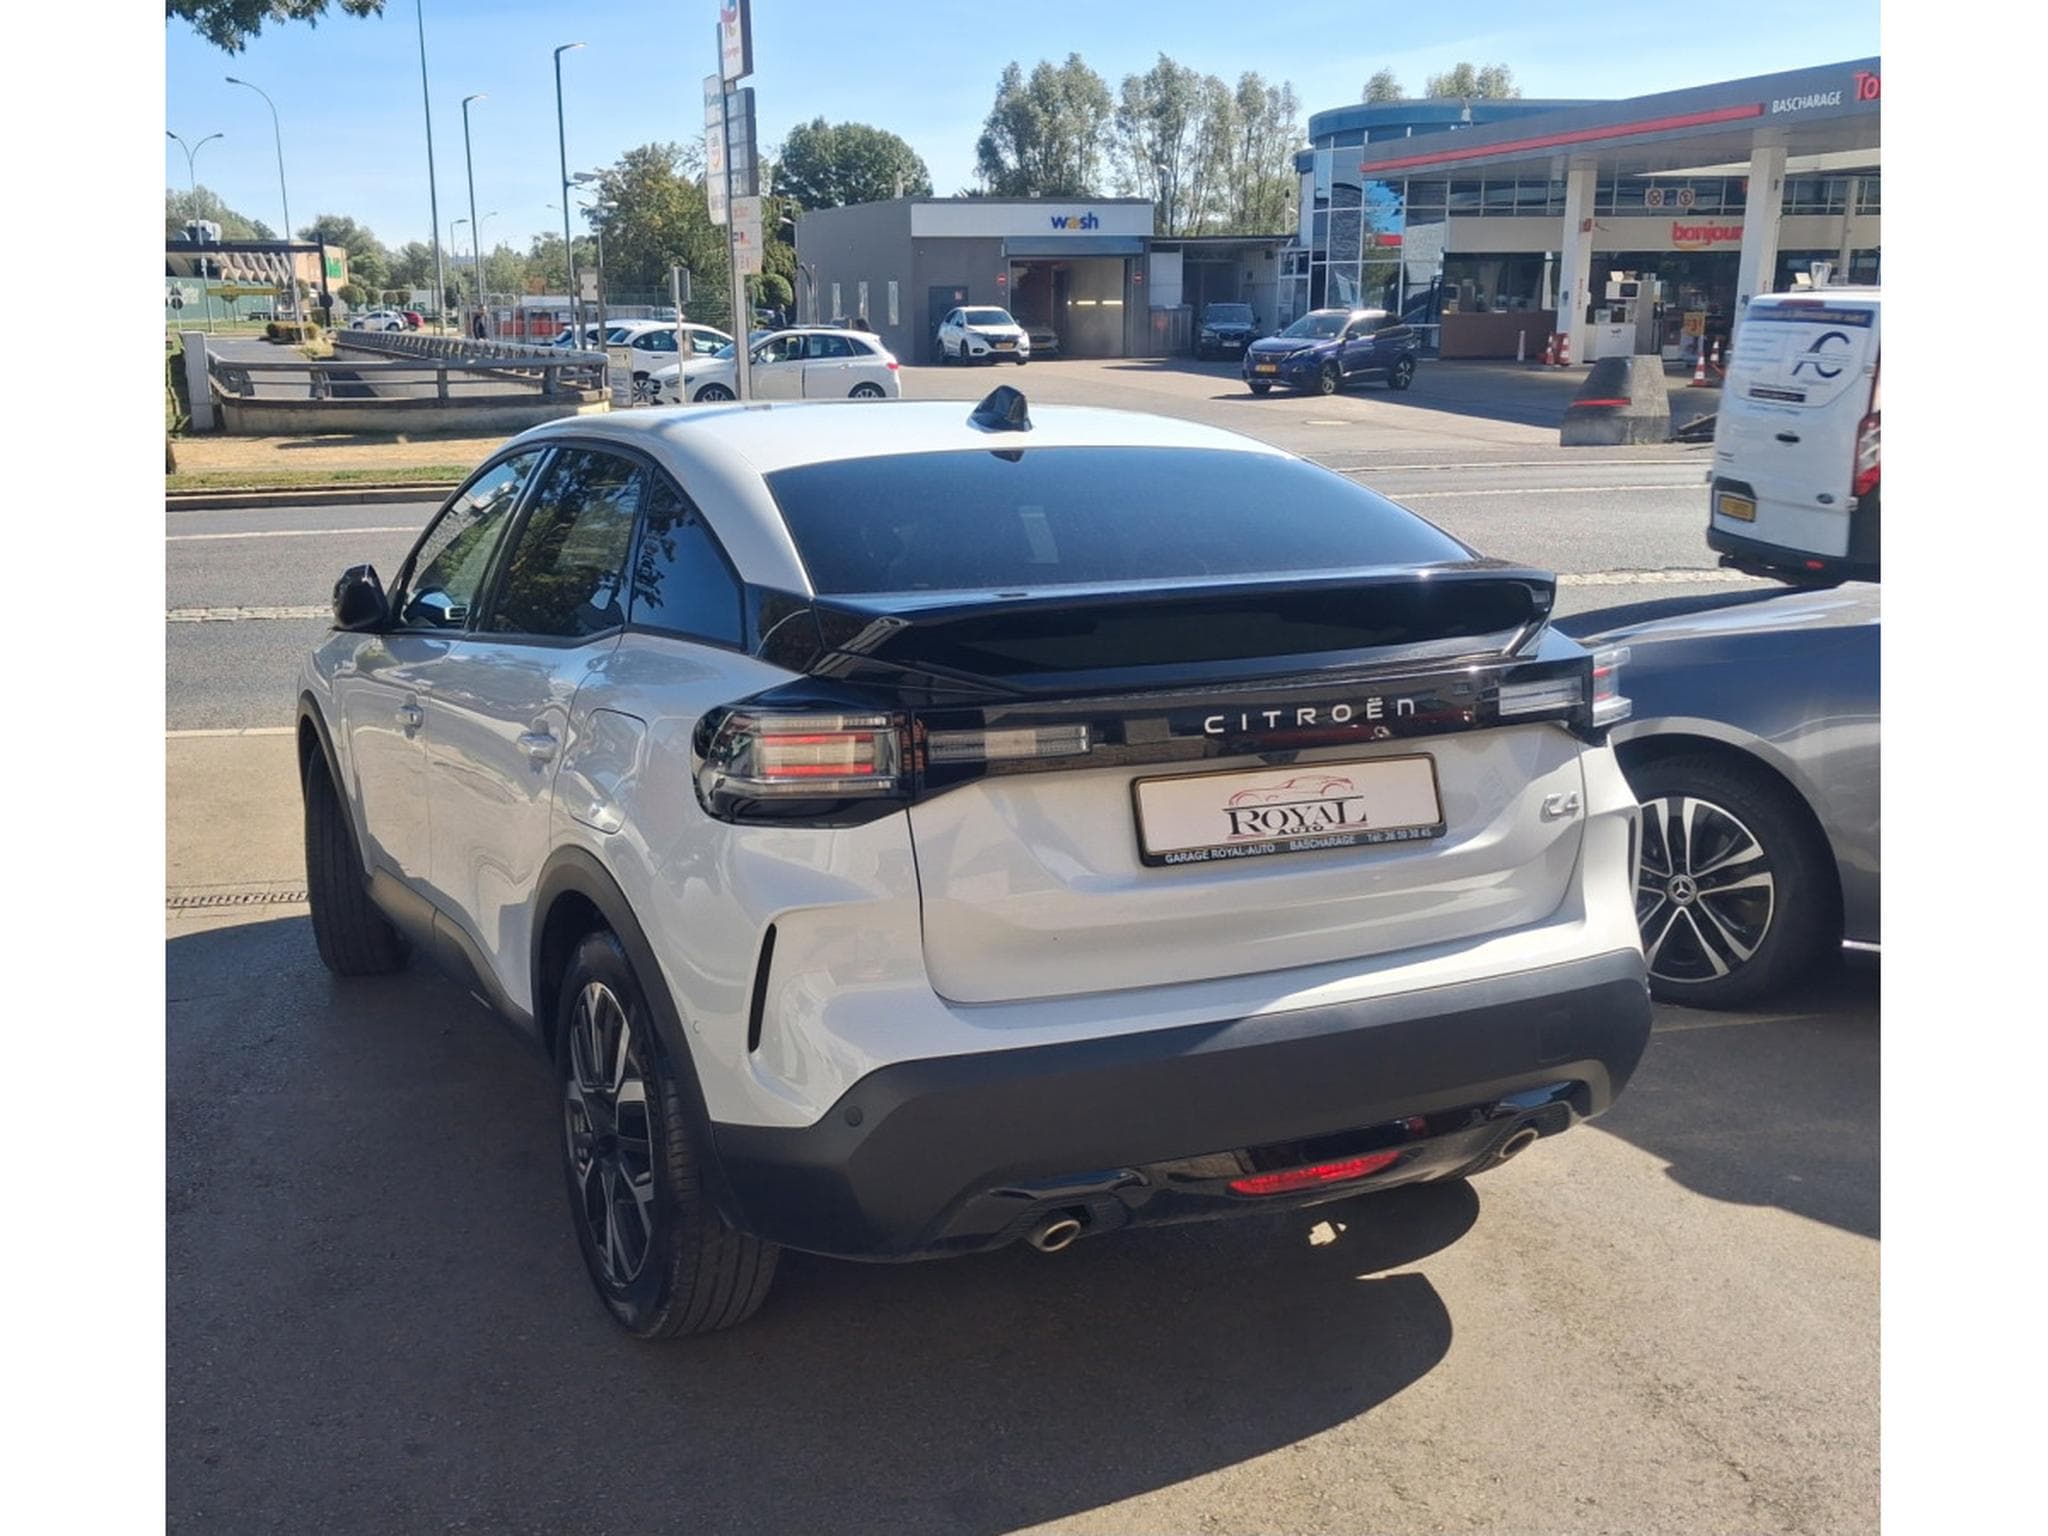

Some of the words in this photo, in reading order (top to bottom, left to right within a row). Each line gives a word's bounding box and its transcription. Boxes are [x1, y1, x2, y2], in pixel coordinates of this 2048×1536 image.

[1772, 91, 1843, 114] BASCHARAGE
[1051, 211, 1099, 230] wash
[1672, 220, 1744, 246] bonjour
[1227, 801, 1368, 835] ROYAL
[1539, 791, 1580, 823] C4
[1277, 825, 1325, 836] AUTO
[1164, 849, 1210, 864] GARAGE
[1289, 836, 1356, 851] BASCHARAGE
